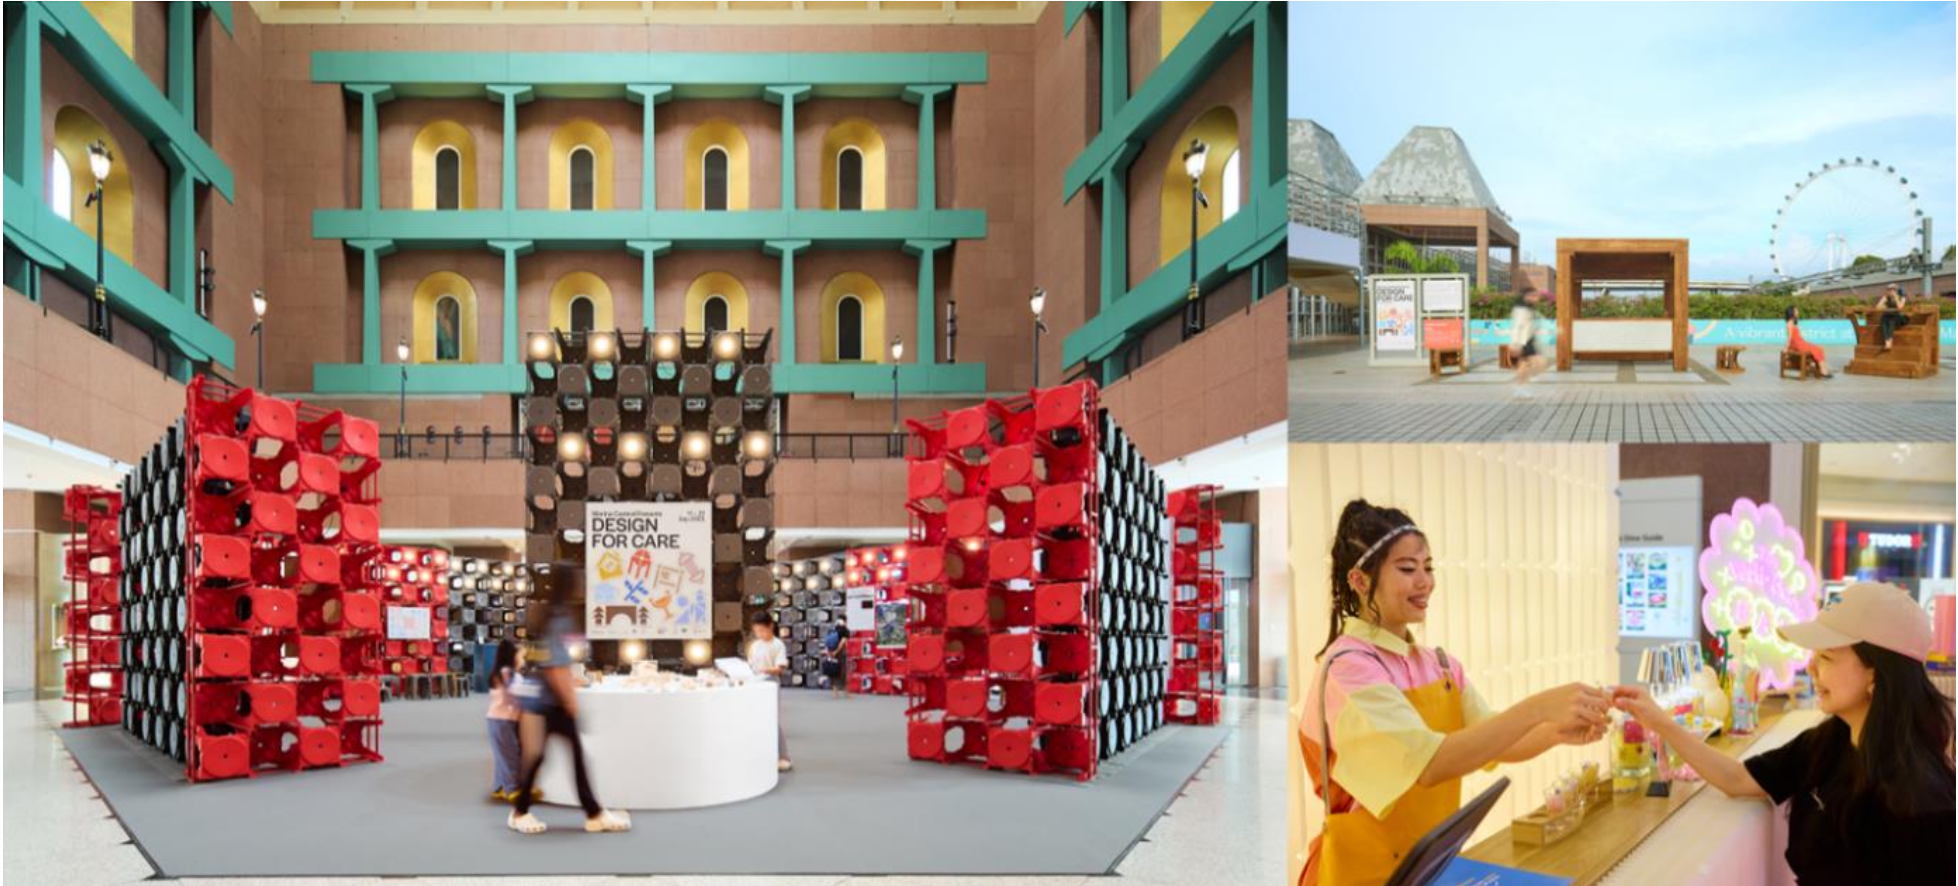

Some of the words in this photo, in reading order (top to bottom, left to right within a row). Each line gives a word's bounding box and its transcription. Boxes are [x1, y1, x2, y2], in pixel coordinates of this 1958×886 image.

[592, 518, 658, 532] DESIGN
[592, 534, 628, 548] FOR
[632, 534, 680, 548] CARE
[1868, 532, 1912, 548] TUDOR
